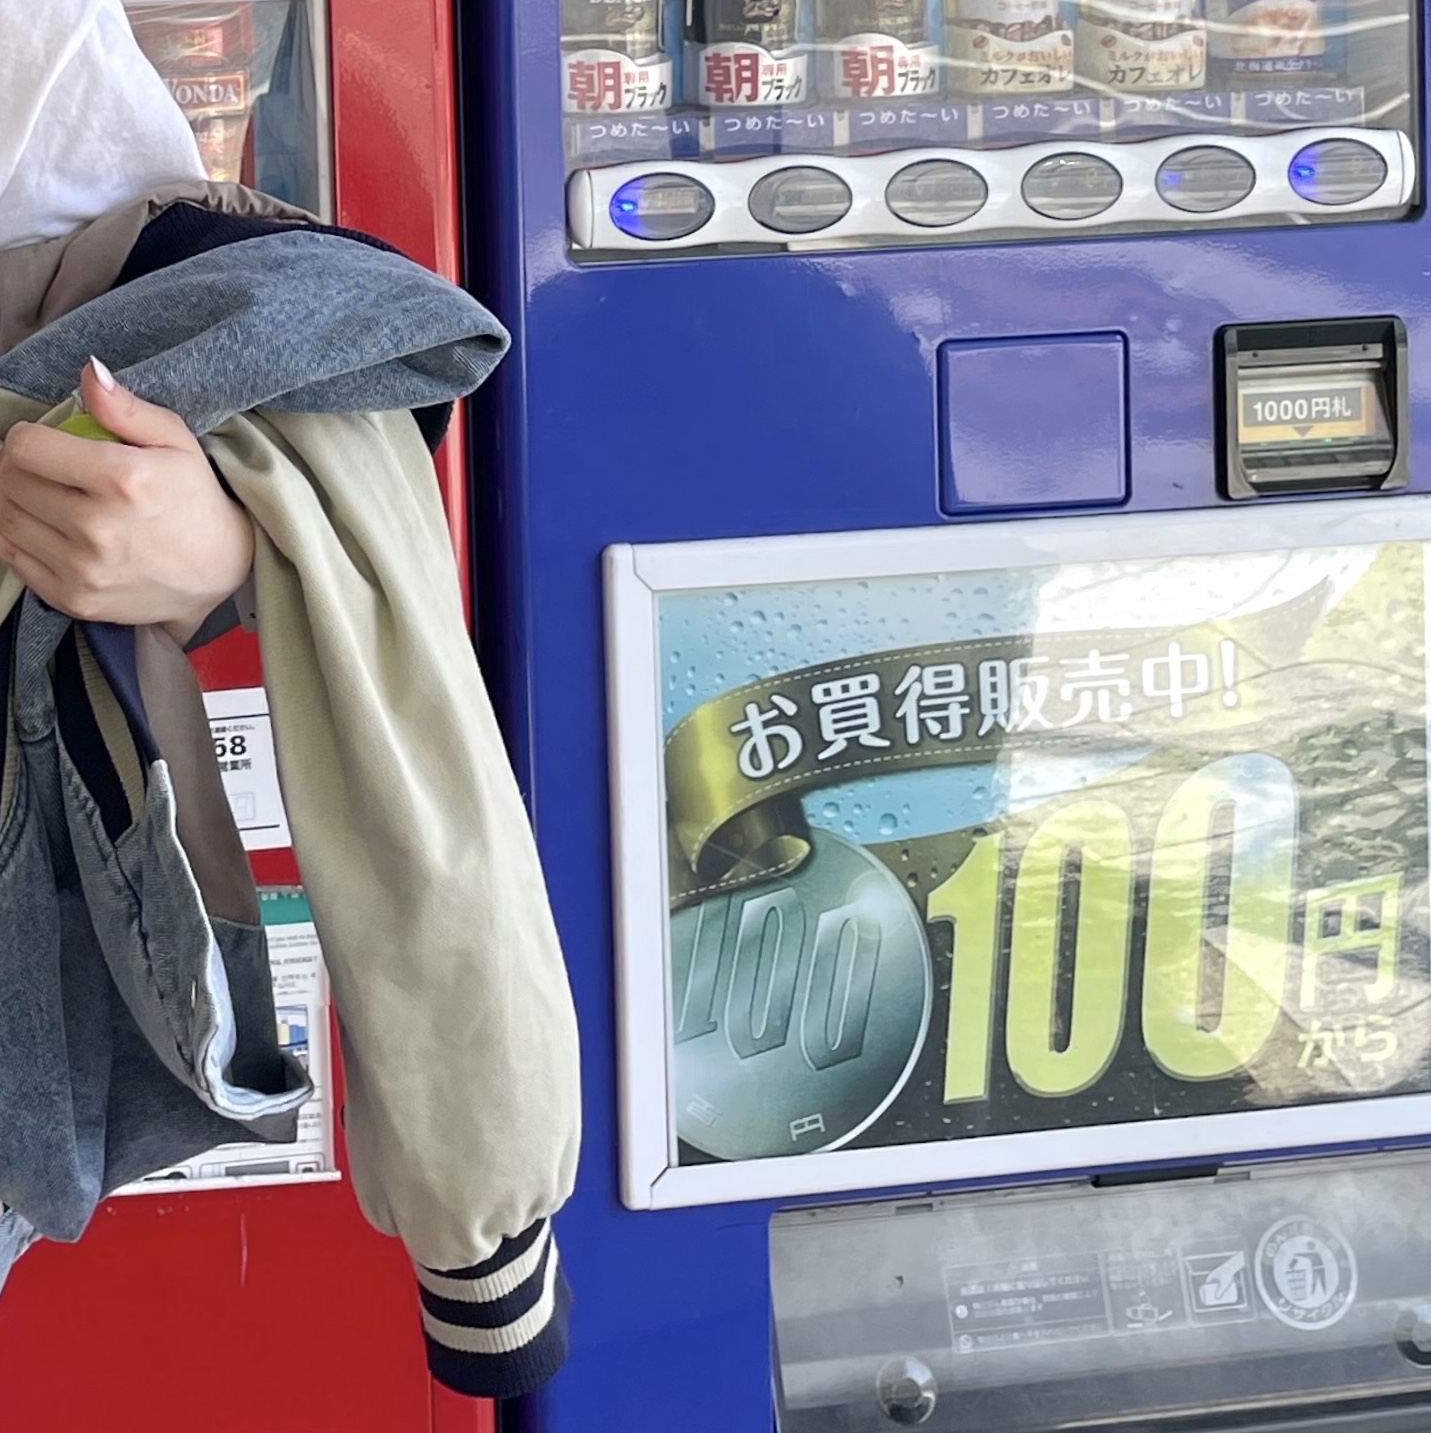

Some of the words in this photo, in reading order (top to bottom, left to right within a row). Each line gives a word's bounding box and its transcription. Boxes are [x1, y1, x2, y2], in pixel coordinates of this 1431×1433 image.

[567, 58, 623, 111] 朝
[704, 52, 760, 103] 朝
[760, 75, 803, 100] ブラック
[840, 44, 896, 97] 朝
[897, 69, 936, 93] ブラック
[980, 66, 1072, 86] カフェオレ
[1108, 63, 1202, 85] カフェオレ
[624, 82, 668, 108] ブラック
[1252, 395, 1352, 423] 1000円札
[729, 638, 1239, 781] お買得販売中!
[925, 751, 1406, 1106] 100円
[1296, 1013, 1398, 1071] から
